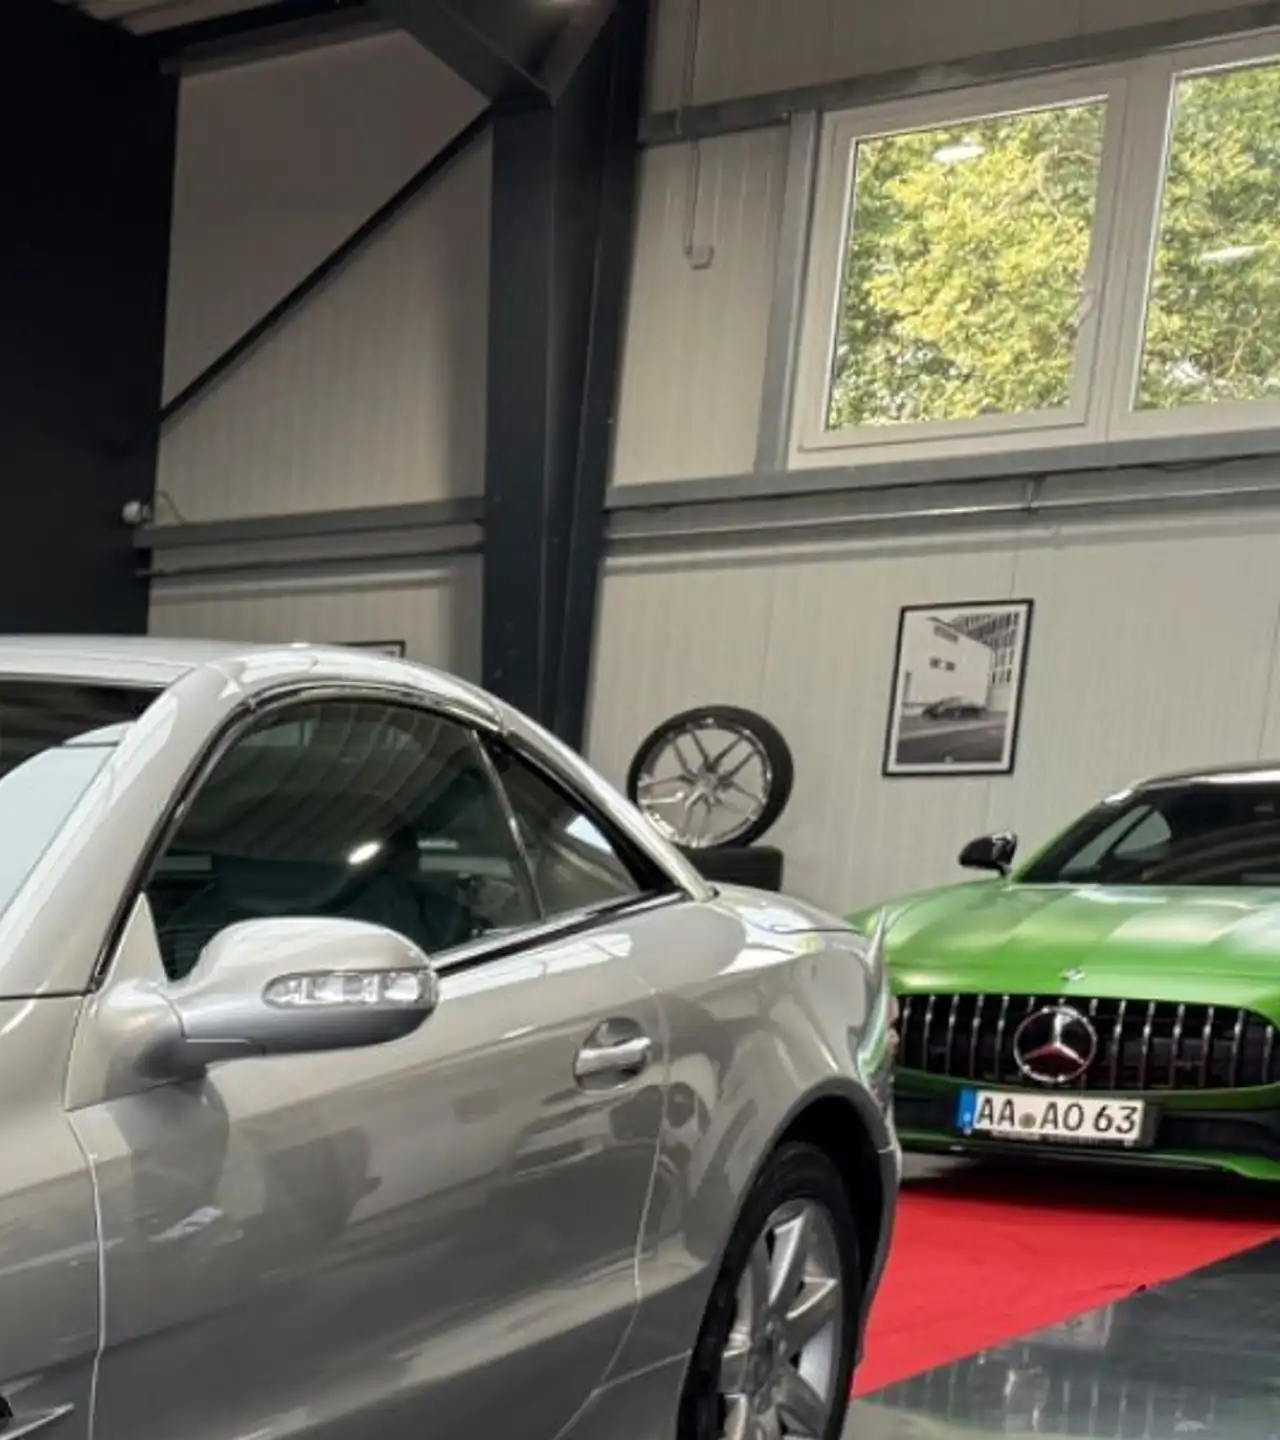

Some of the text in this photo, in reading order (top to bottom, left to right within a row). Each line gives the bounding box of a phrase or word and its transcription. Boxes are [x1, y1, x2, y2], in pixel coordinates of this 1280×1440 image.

[976, 1097, 1138, 1135] AA AO 63
